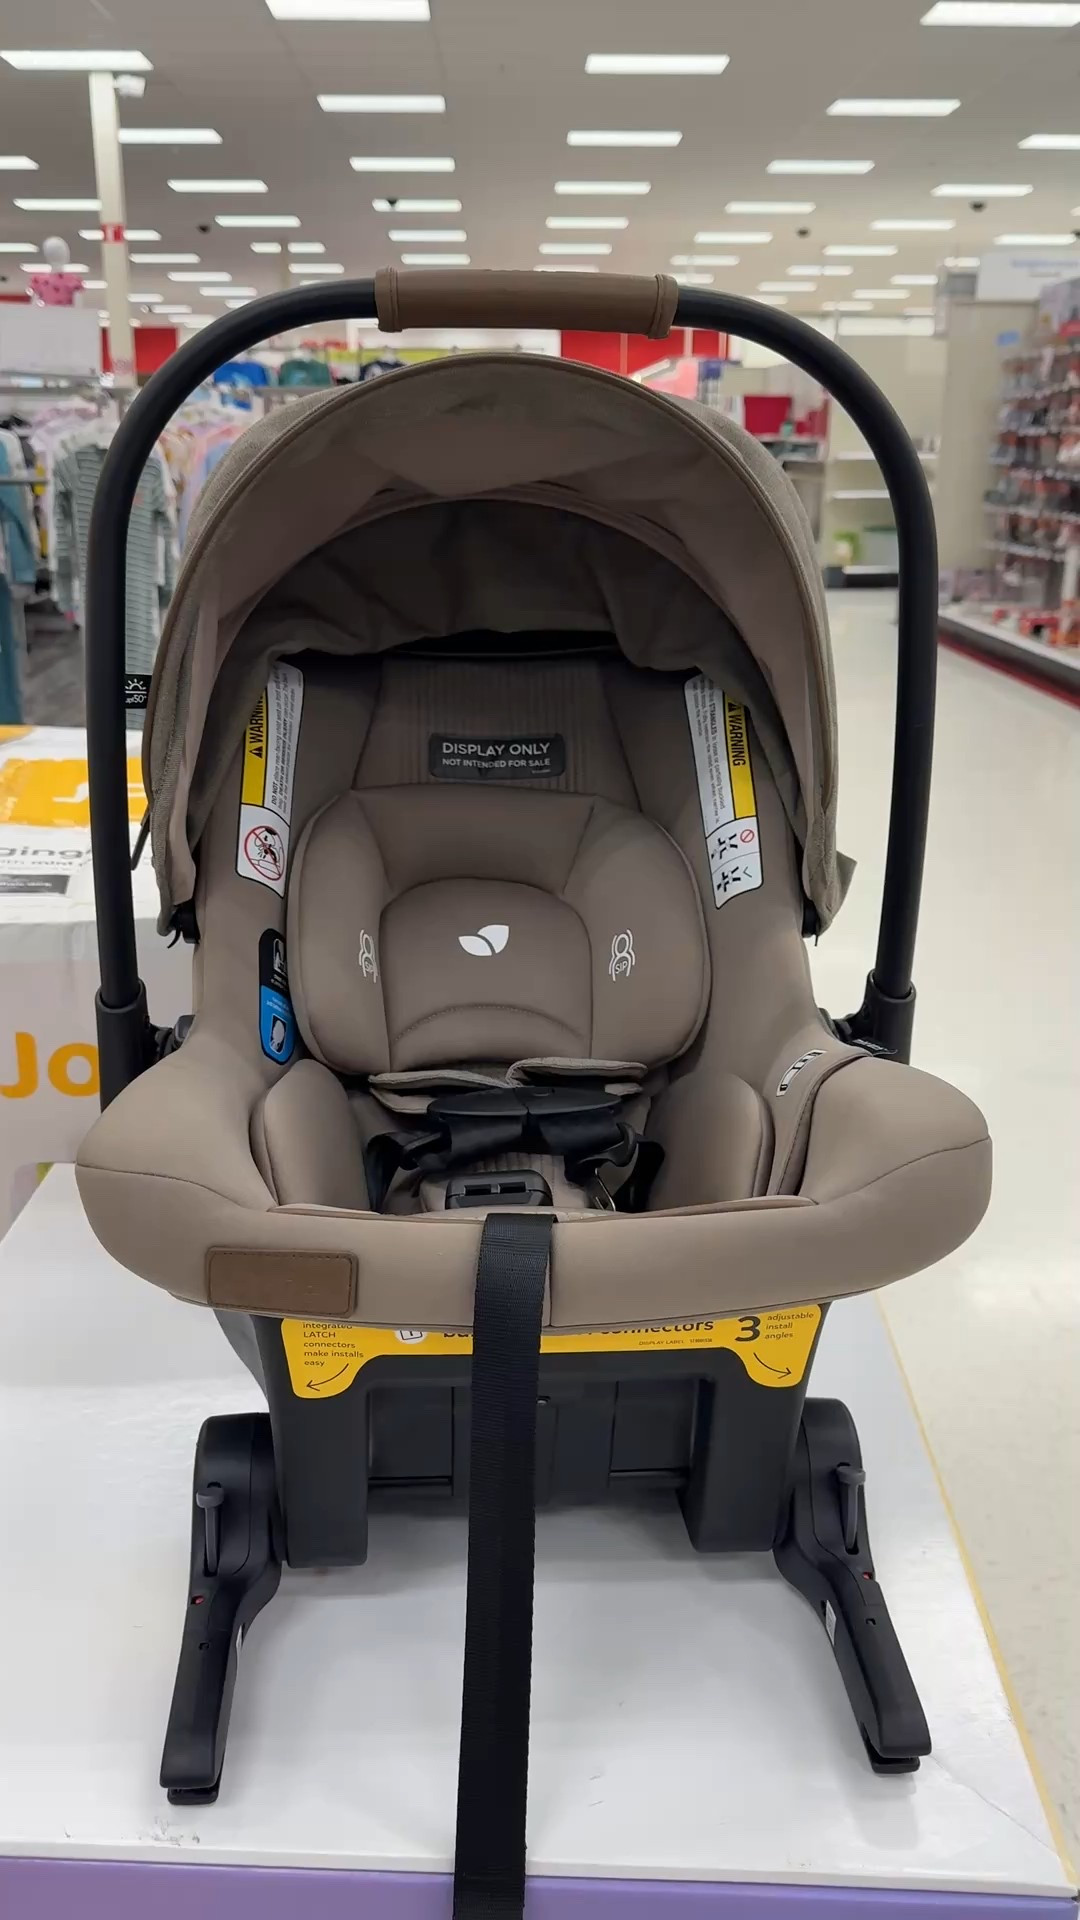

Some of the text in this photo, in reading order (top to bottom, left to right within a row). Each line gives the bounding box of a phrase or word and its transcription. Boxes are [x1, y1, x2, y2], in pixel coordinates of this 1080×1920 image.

[709, 703, 717, 736] STRANGLED
[729, 714, 746, 766] WARNING
[442, 742, 550, 757] DISPLAY ONLY
[442, 758, 551, 769] NOT INTENDED FOR SALE
[271, 795, 277, 805] DO
[616, 961, 628, 974] SIP
[768, 1312, 814, 1321] adjustable
[735, 1316, 793, 1342] 3 install
[765, 1332, 793, 1340] angles
[303, 1341, 356, 1349] connectors
[331, 1350, 364, 1358] installs
